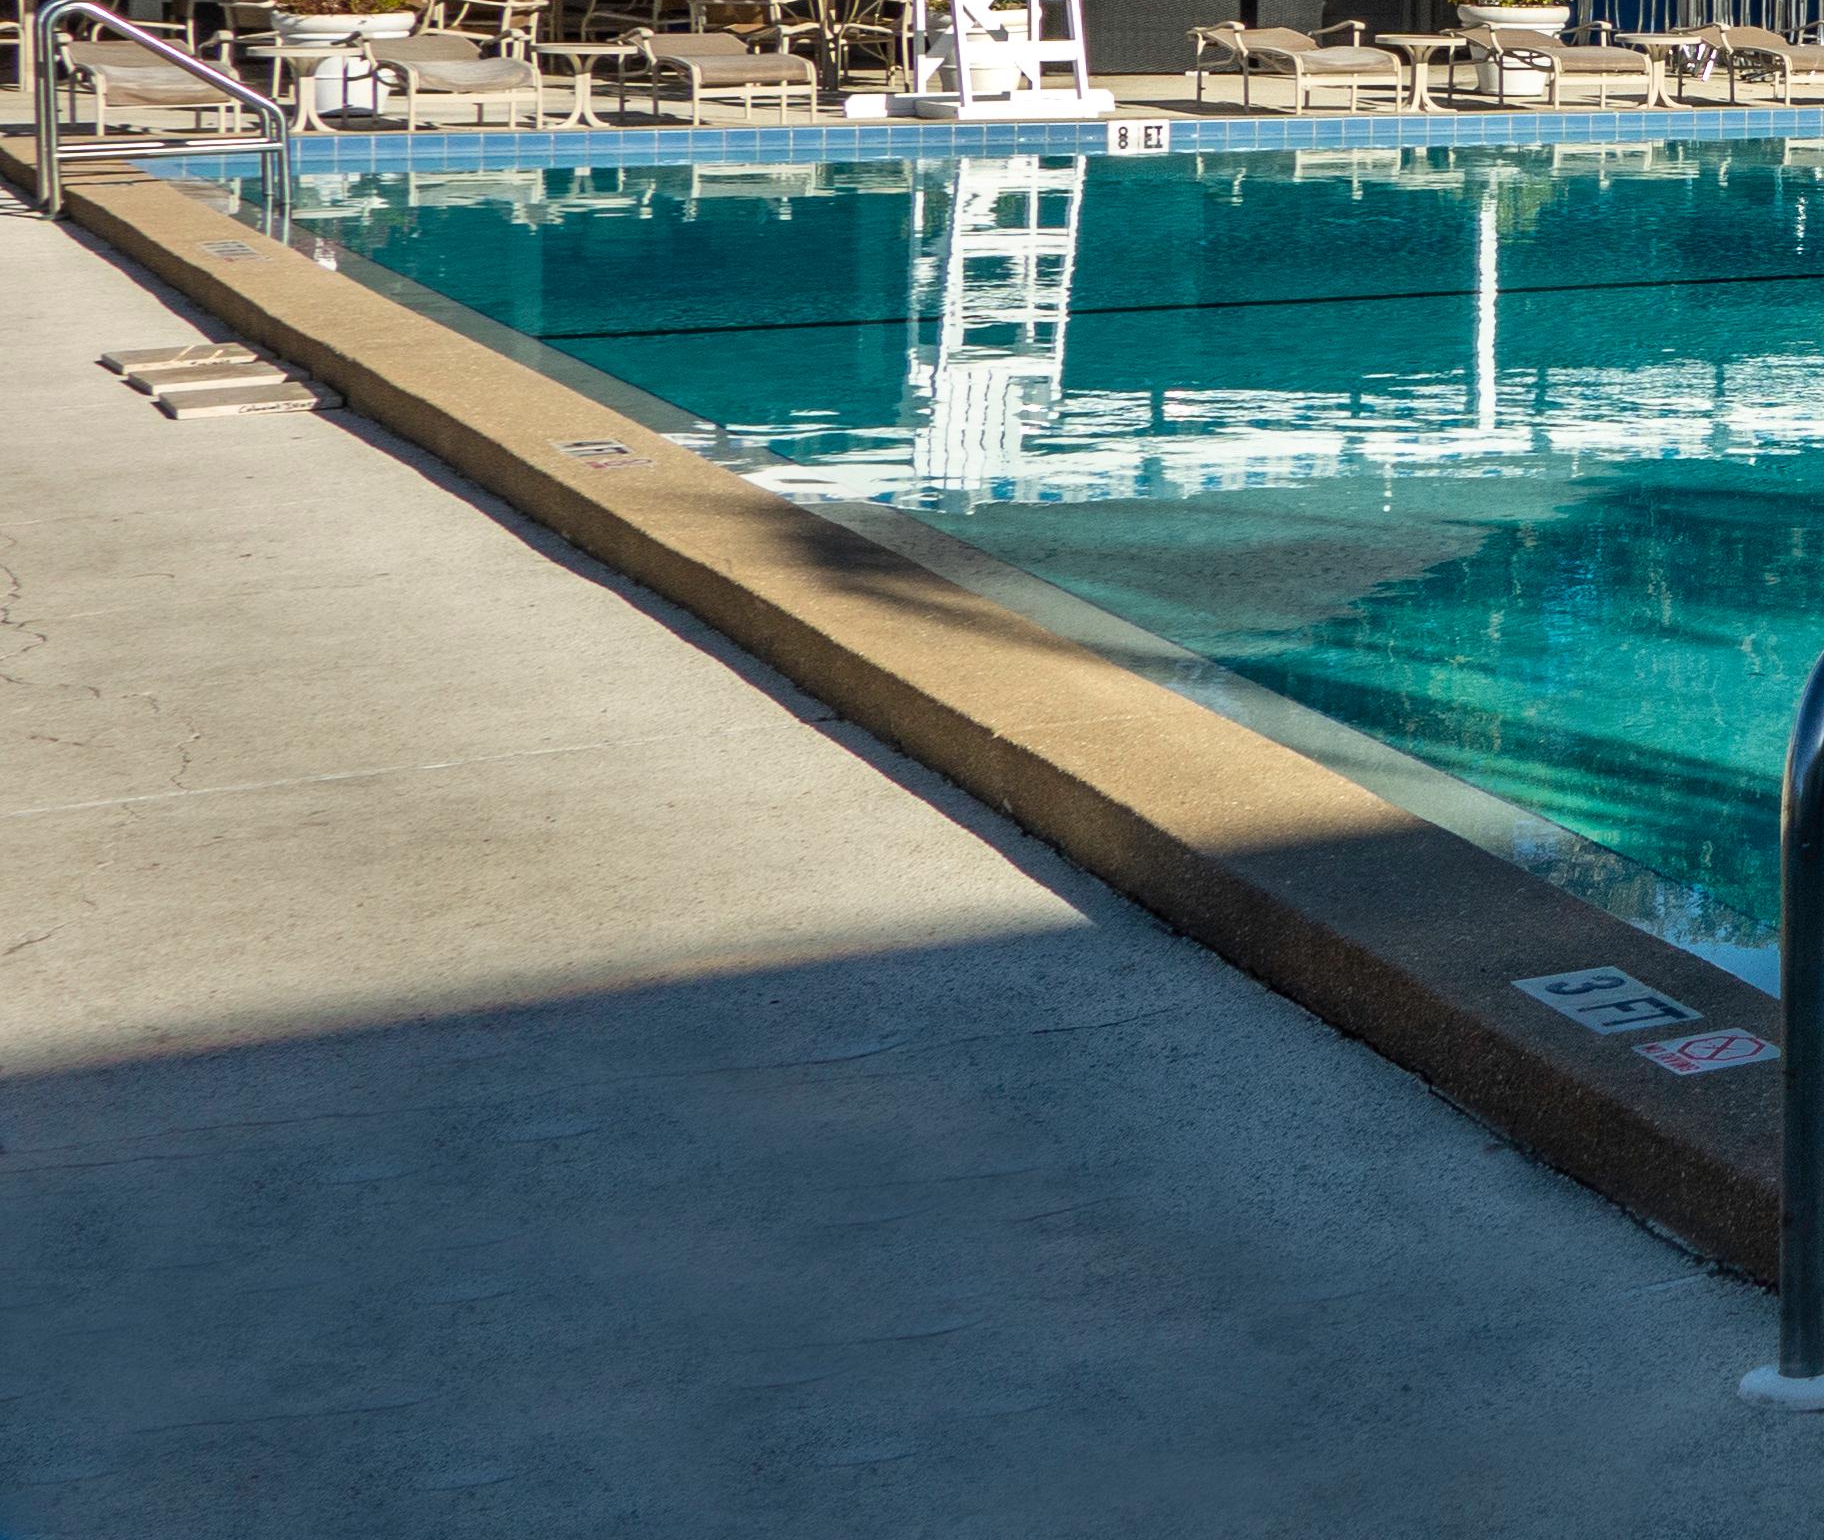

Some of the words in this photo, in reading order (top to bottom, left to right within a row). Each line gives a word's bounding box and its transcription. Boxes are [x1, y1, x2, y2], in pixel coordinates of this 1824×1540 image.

[1118, 126, 1128, 145] 8
[1545, 974, 1625, 996] 3
[1576, 996, 1690, 1027] FT
